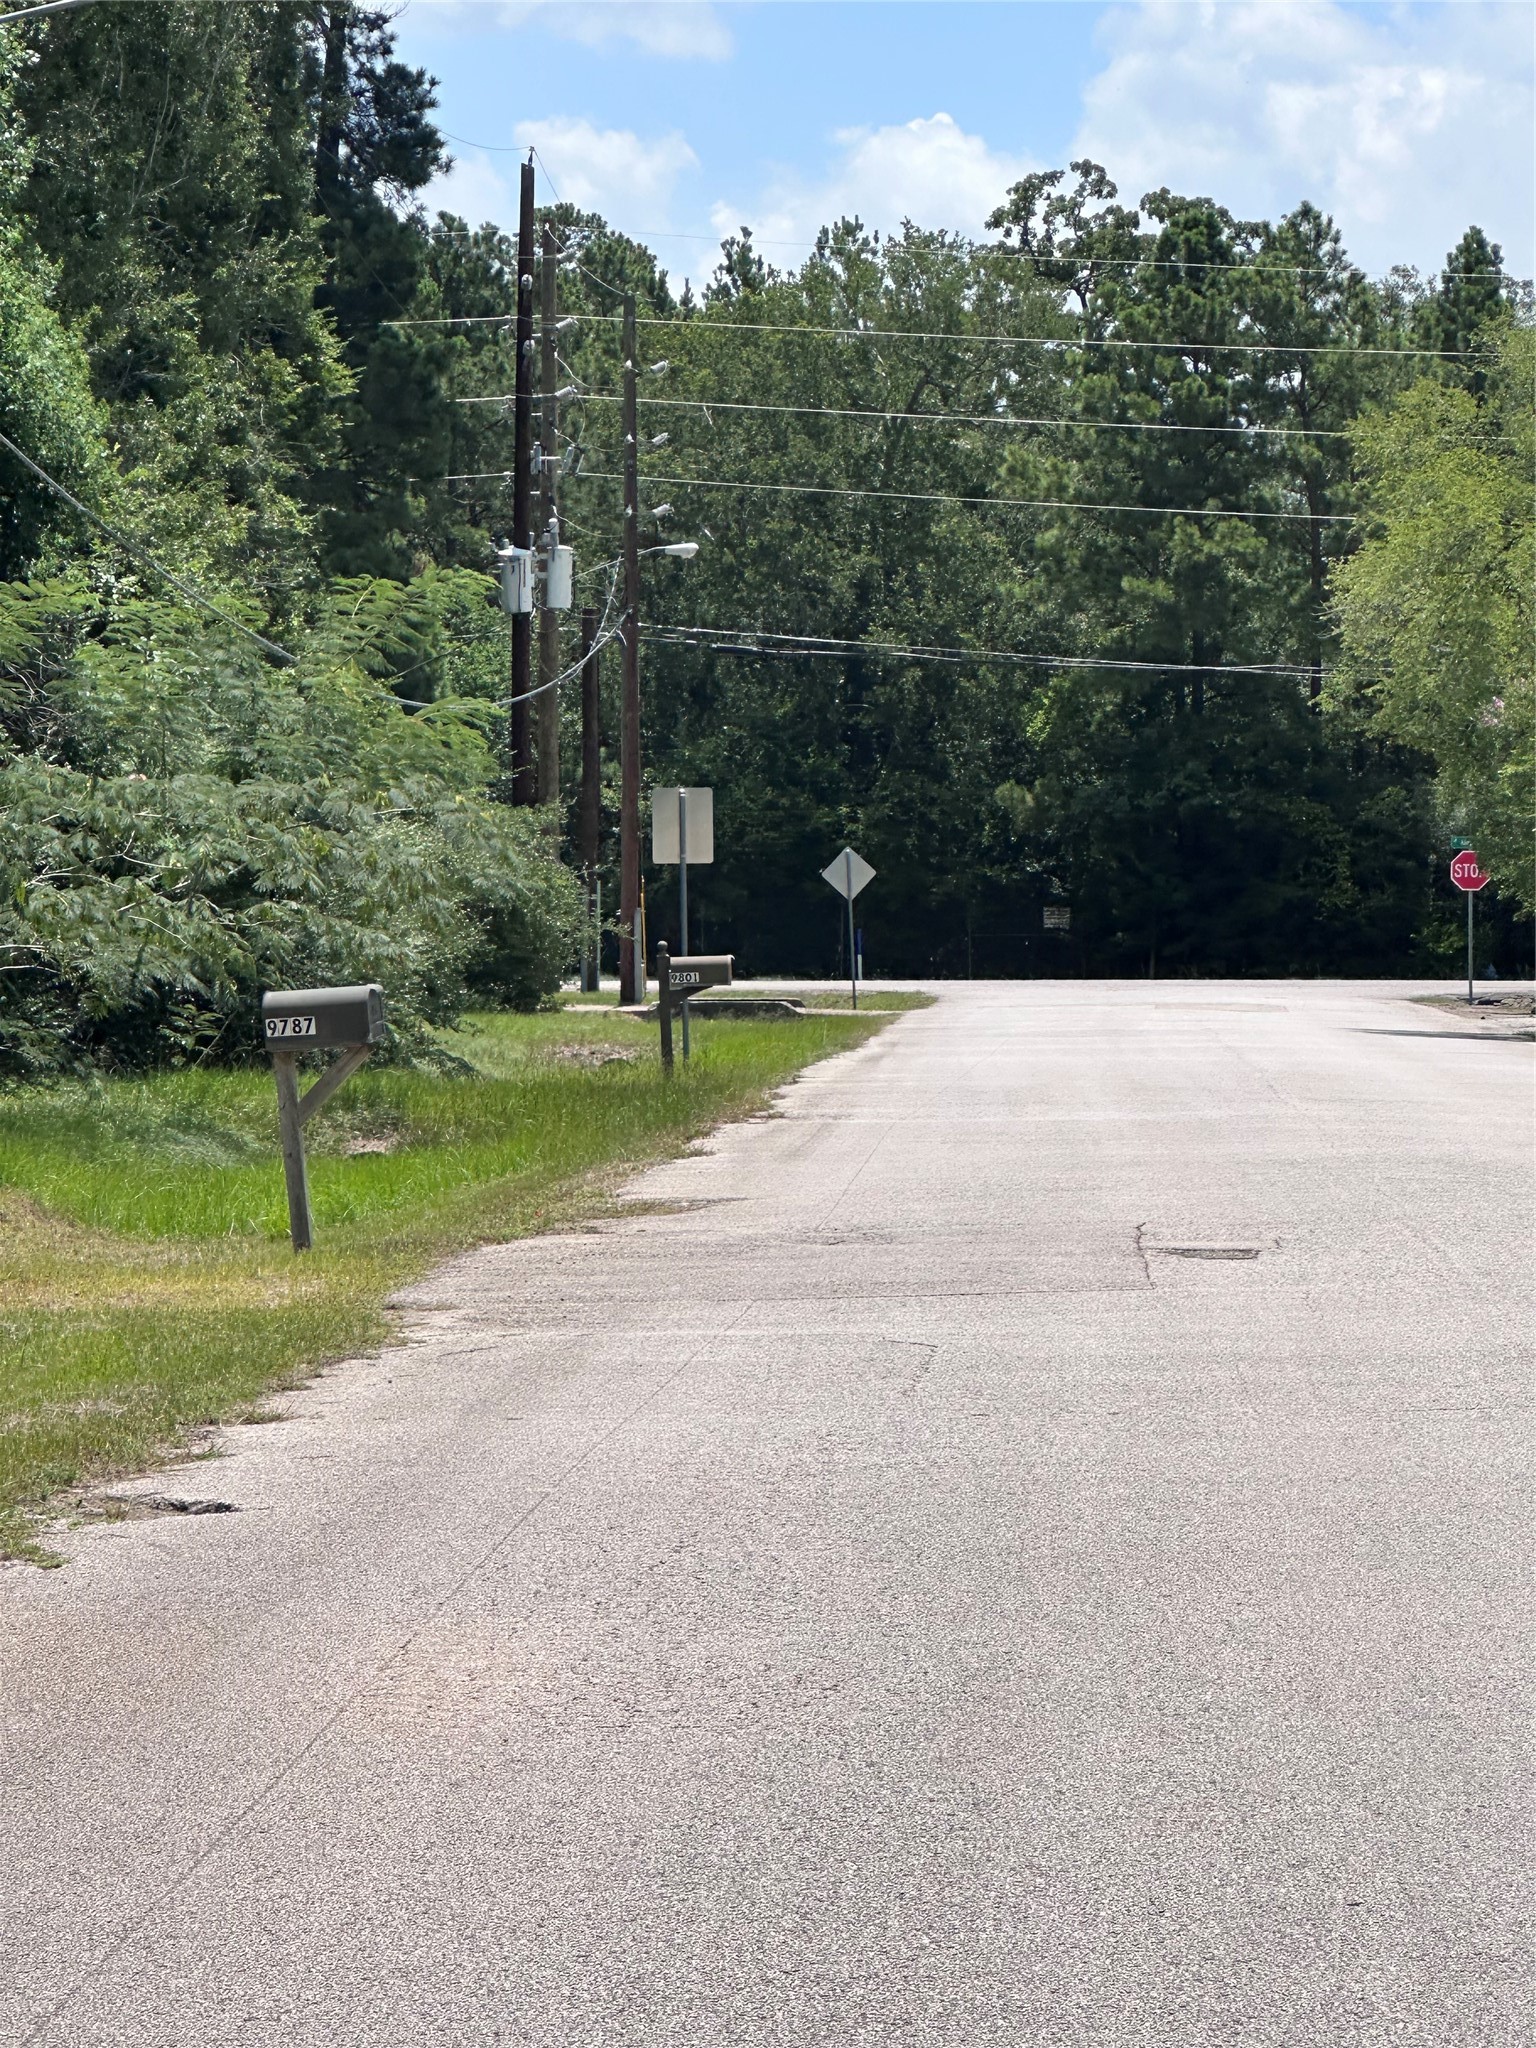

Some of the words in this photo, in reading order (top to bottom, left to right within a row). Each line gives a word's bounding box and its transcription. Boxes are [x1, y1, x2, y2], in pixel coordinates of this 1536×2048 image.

[1454, 863, 1482, 878] STO
[671, 973, 698, 983] 9801
[267, 1017, 313, 1036] 9787
